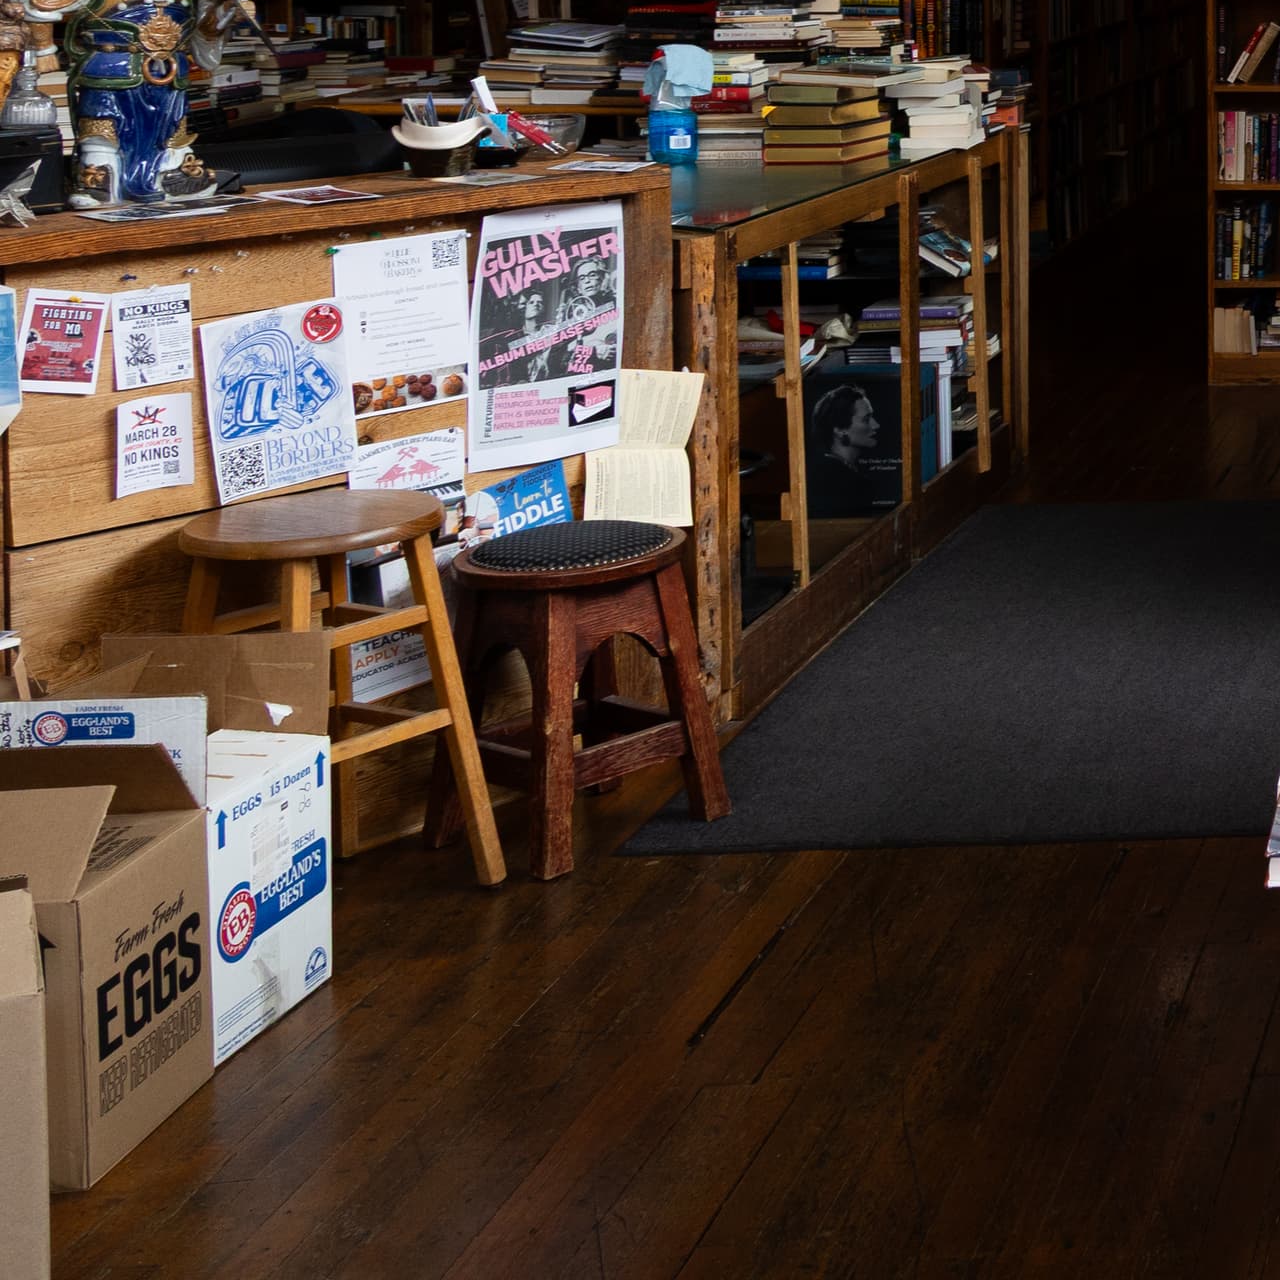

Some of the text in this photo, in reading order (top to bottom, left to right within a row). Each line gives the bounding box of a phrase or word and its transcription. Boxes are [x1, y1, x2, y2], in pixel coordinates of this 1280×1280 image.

[480, 226, 563, 278] GULLY
[489, 232, 621, 300] WASHER
[42, 307, 93, 321] FIGHTING
[124, 300, 186, 316] NO KINGS
[43, 321, 82, 335] FOR MO
[131, 333, 146, 342] NO
[479, 308, 619, 374] ALBUM RELEASE SHOW
[126, 353, 156, 367] KINGS
[575, 344, 593, 357] FRI
[575, 354, 590, 364] 27
[568, 363, 593, 374] MAR
[484, 389, 494, 438] FEATURING
[124, 425, 177, 444] MARCH 28
[267, 426, 342, 456] BEYOND
[124, 451, 137, 466] NO
[140, 445, 179, 463] KINGS
[268, 438, 354, 471] BORDERS
[514, 479, 553, 509] Learn to
[490, 493, 565, 540] FIDDLE
[354, 645, 400, 670] APPLY
[89, 726, 115, 736] BEST
[232, 765, 311, 821] EGGS 15 Dozen
[279, 879, 306, 912] BEST
[114, 889, 184, 963] Farm Fresh
[228, 908, 249, 939] EB
[96, 911, 201, 1062] EGGS
[100, 1055, 128, 1118] KEEP
